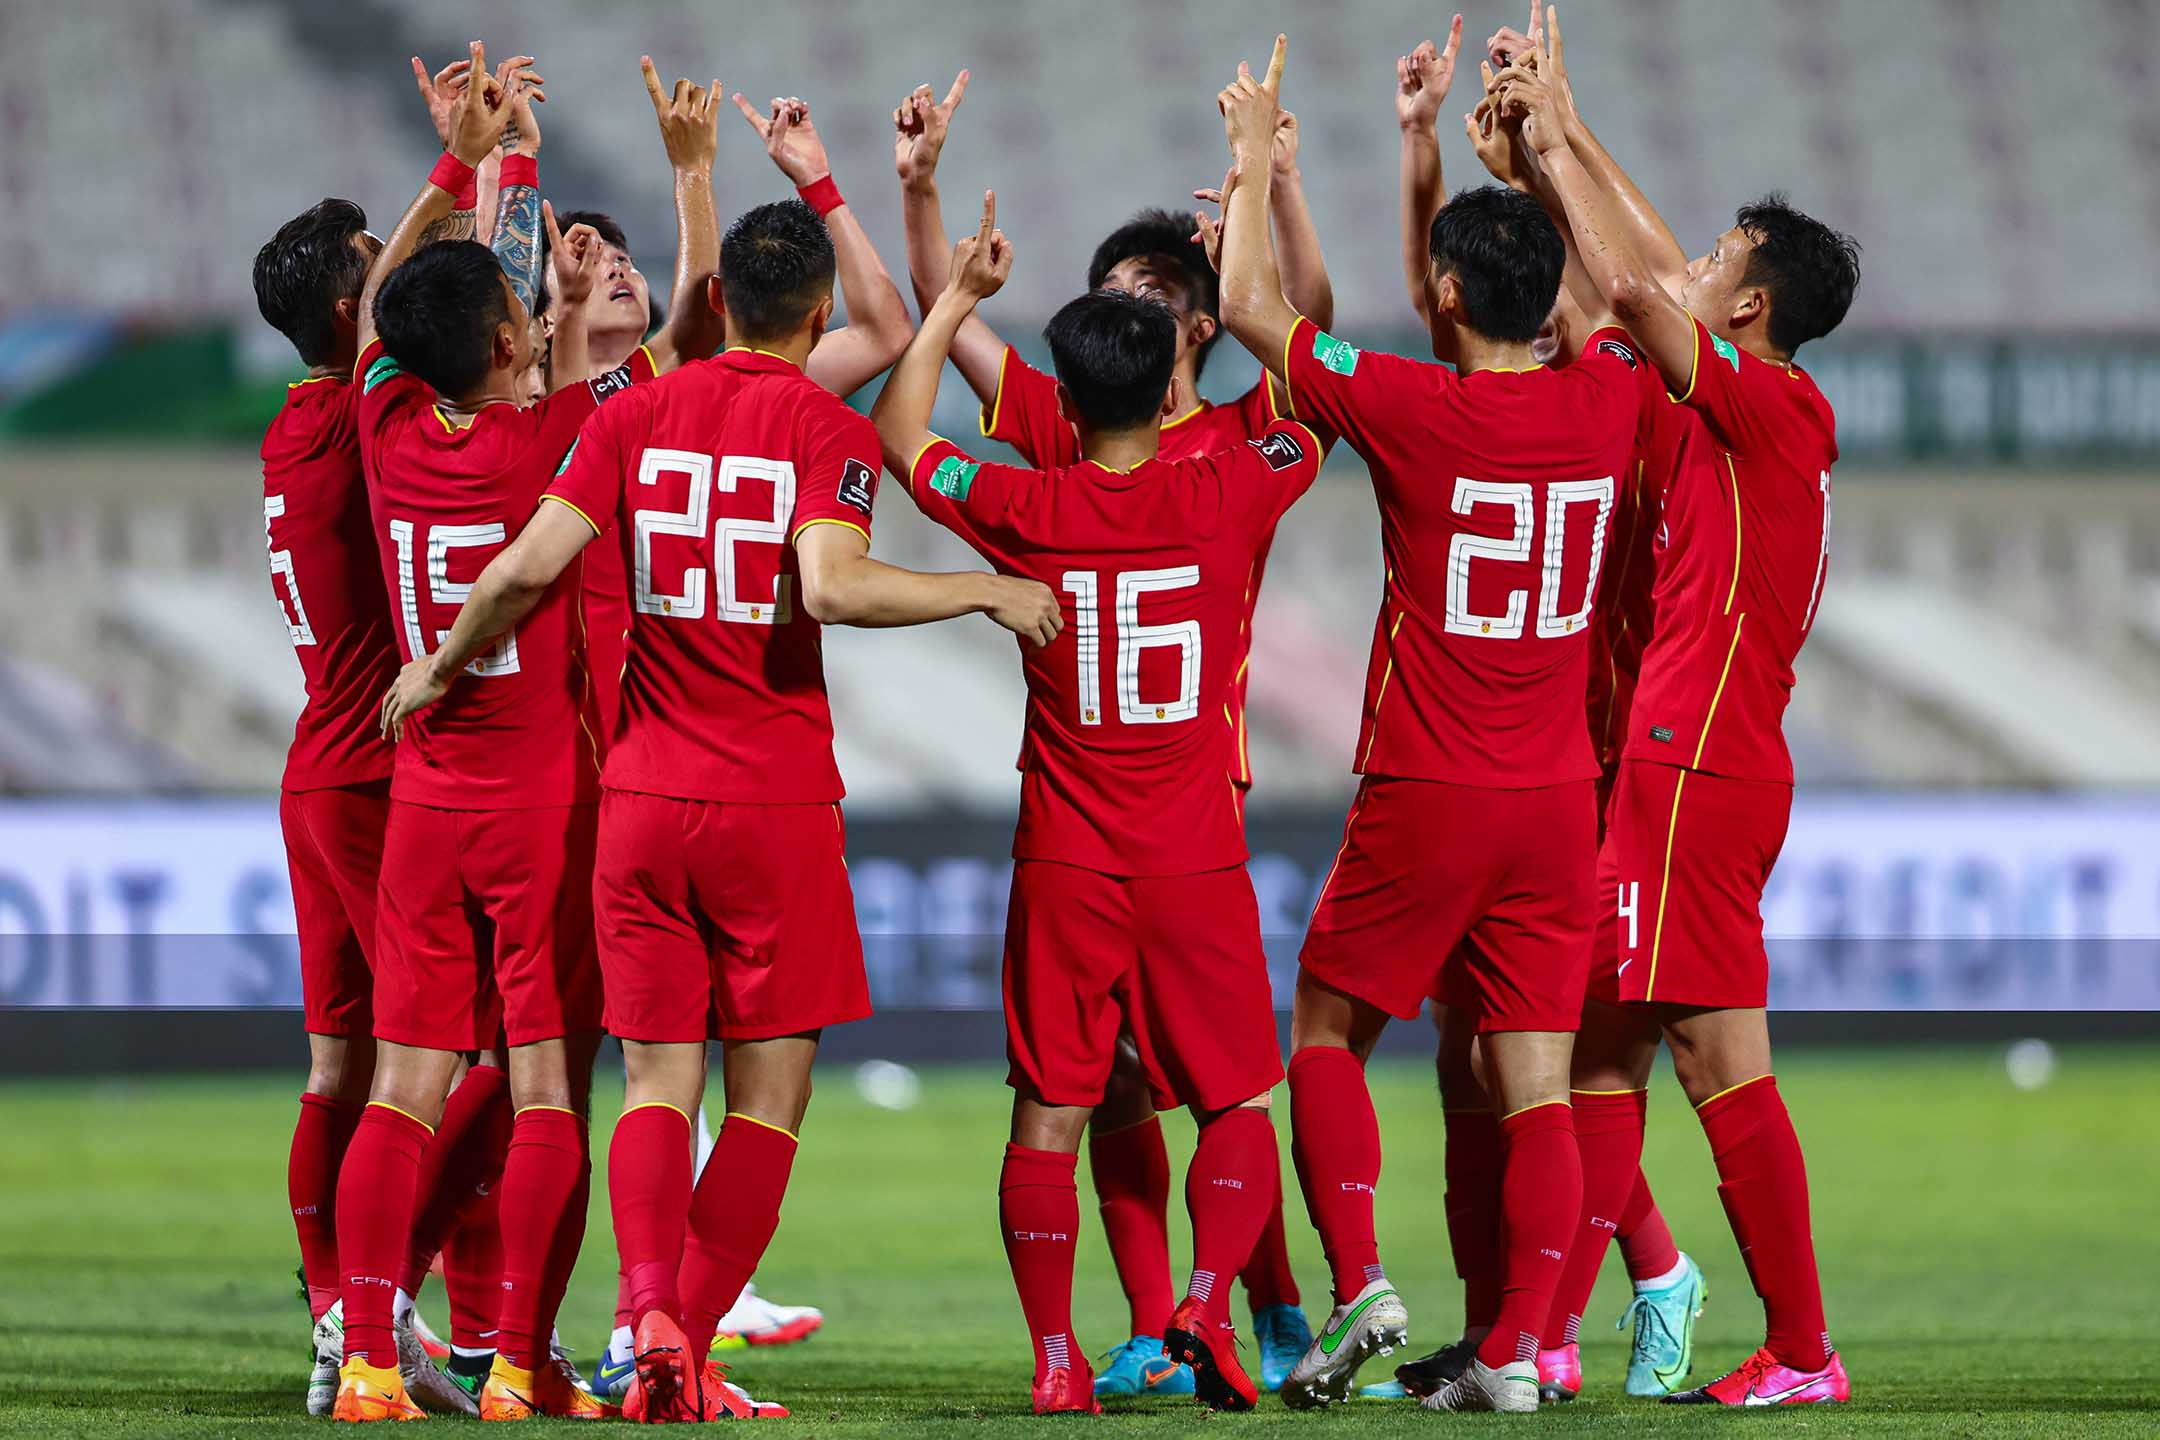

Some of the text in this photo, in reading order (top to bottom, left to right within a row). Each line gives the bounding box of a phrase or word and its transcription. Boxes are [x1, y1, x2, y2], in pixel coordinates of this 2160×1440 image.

[389, 518, 521, 677] 15
[635, 447, 797, 625] 22
[1444, 475, 1615, 640] 20
[1062, 564, 1202, 726] 16
[1618, 881, 1639, 949] 4
[351, 1276, 392, 1288] CFA
[1014, 1231, 1067, 1241] CFA
